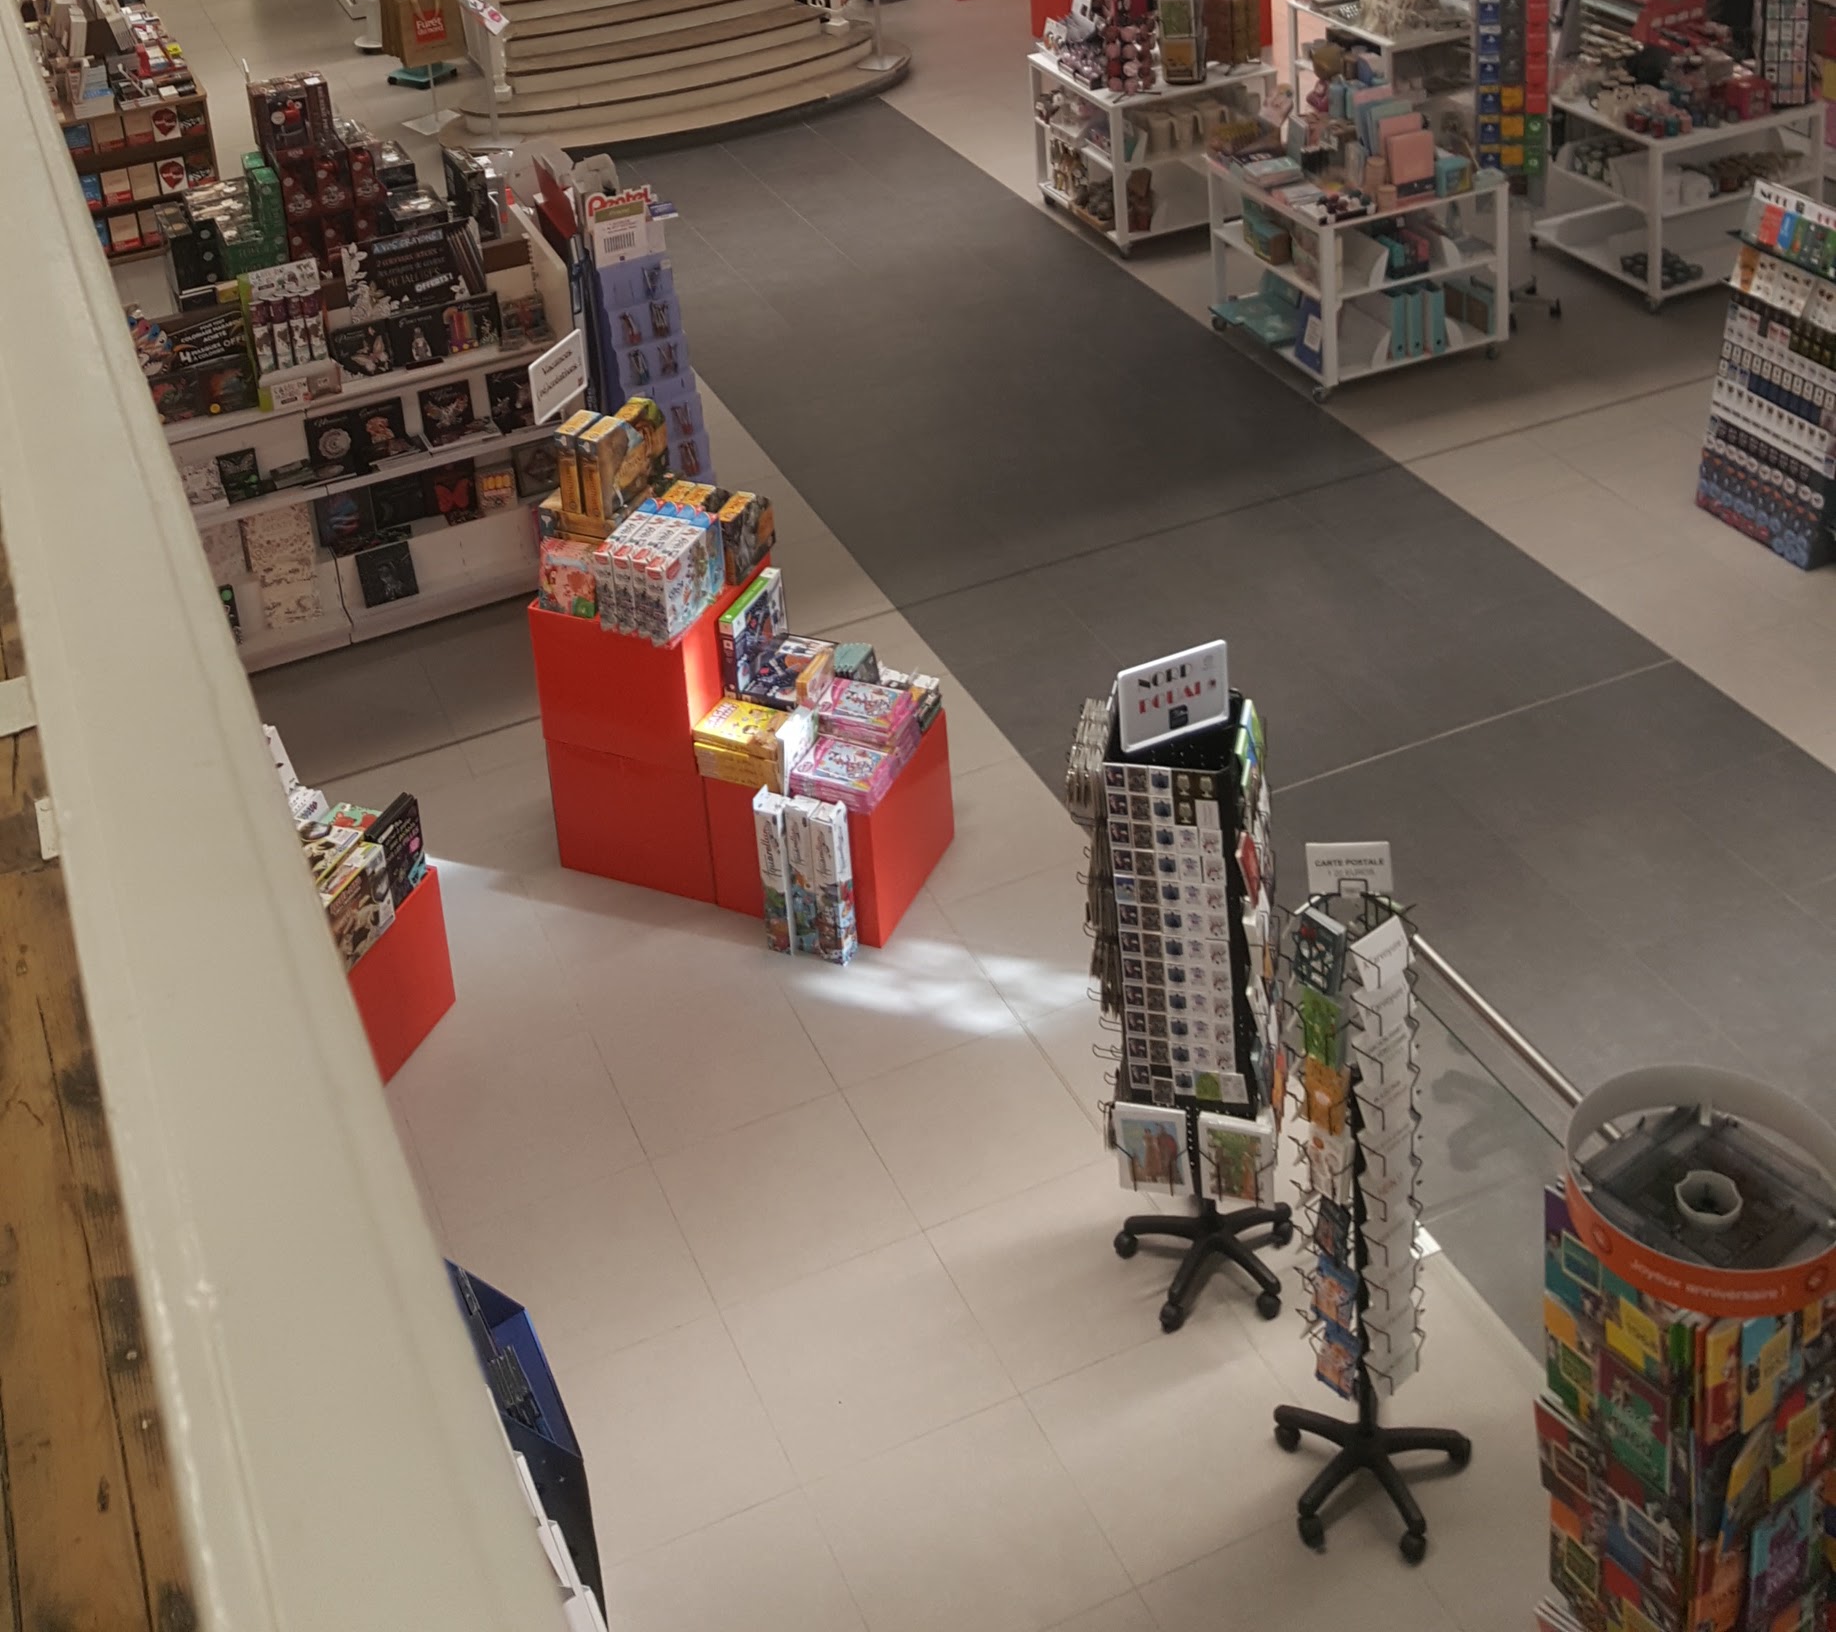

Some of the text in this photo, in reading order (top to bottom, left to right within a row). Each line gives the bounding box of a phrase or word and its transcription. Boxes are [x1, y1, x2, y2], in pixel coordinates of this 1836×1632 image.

[416, 17, 444, 31] Furet
[1314, 857, 1385, 868] CARTE POSTALE
